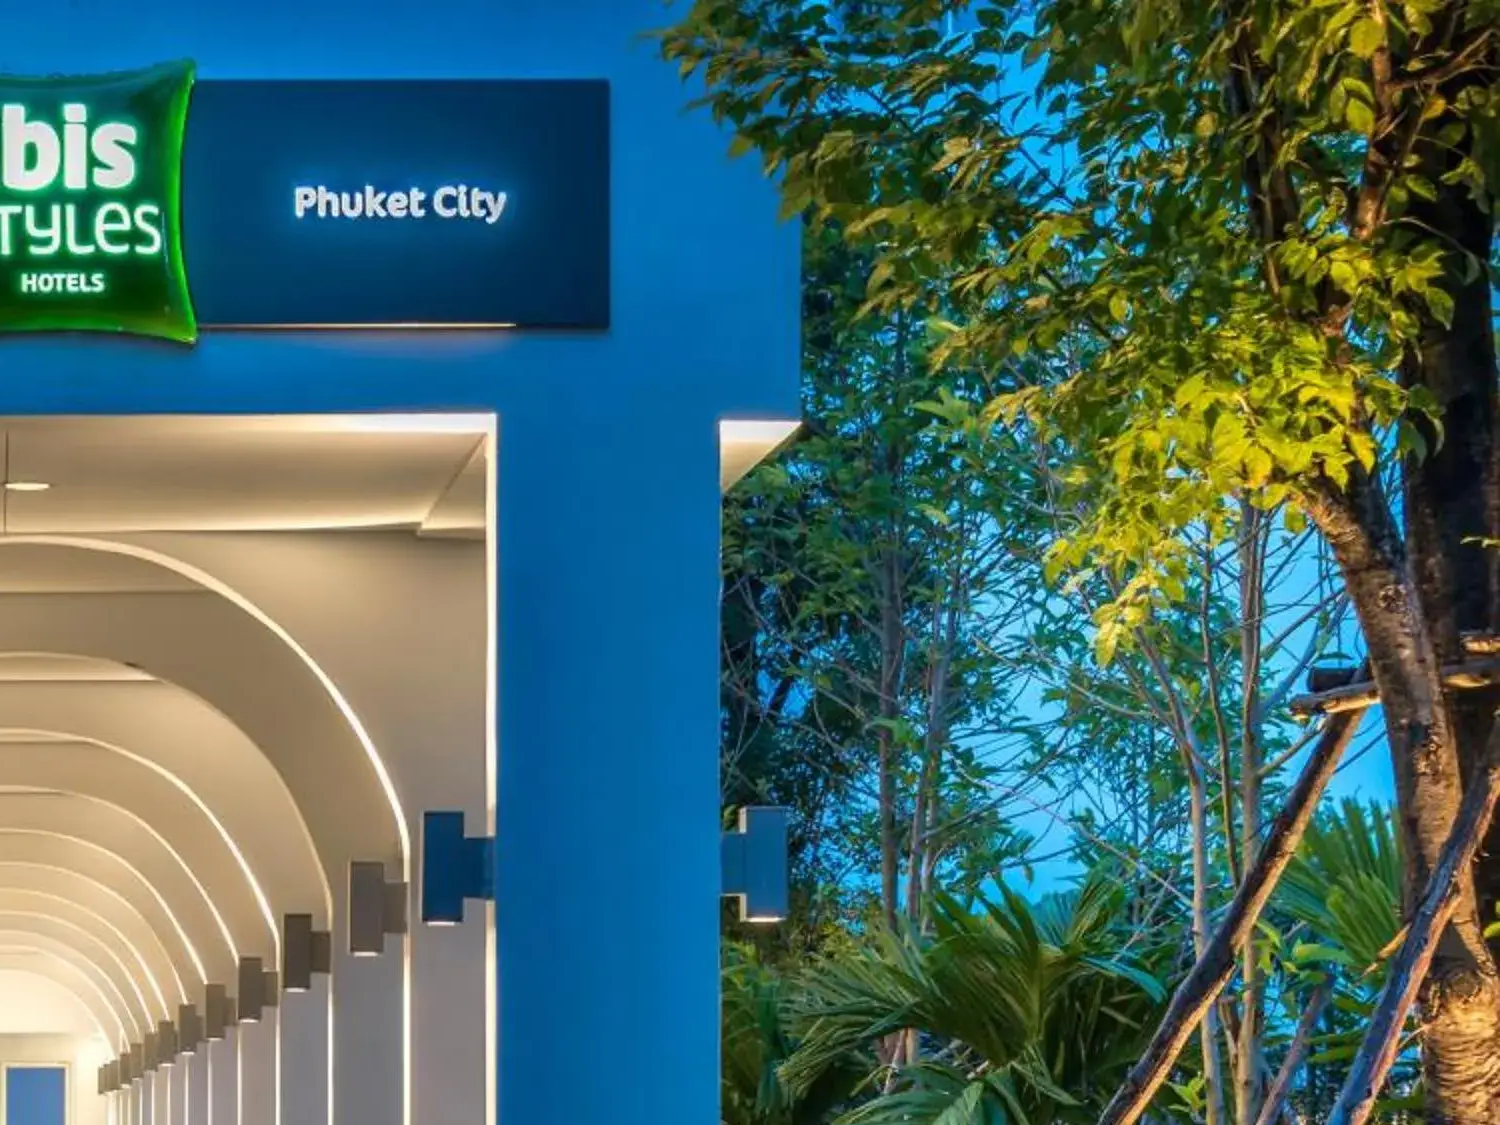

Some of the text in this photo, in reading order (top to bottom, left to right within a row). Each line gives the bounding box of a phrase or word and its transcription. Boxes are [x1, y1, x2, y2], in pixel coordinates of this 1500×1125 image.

[294, 185, 508, 224] Phuket City
[20, 273, 105, 294] HOTELS
